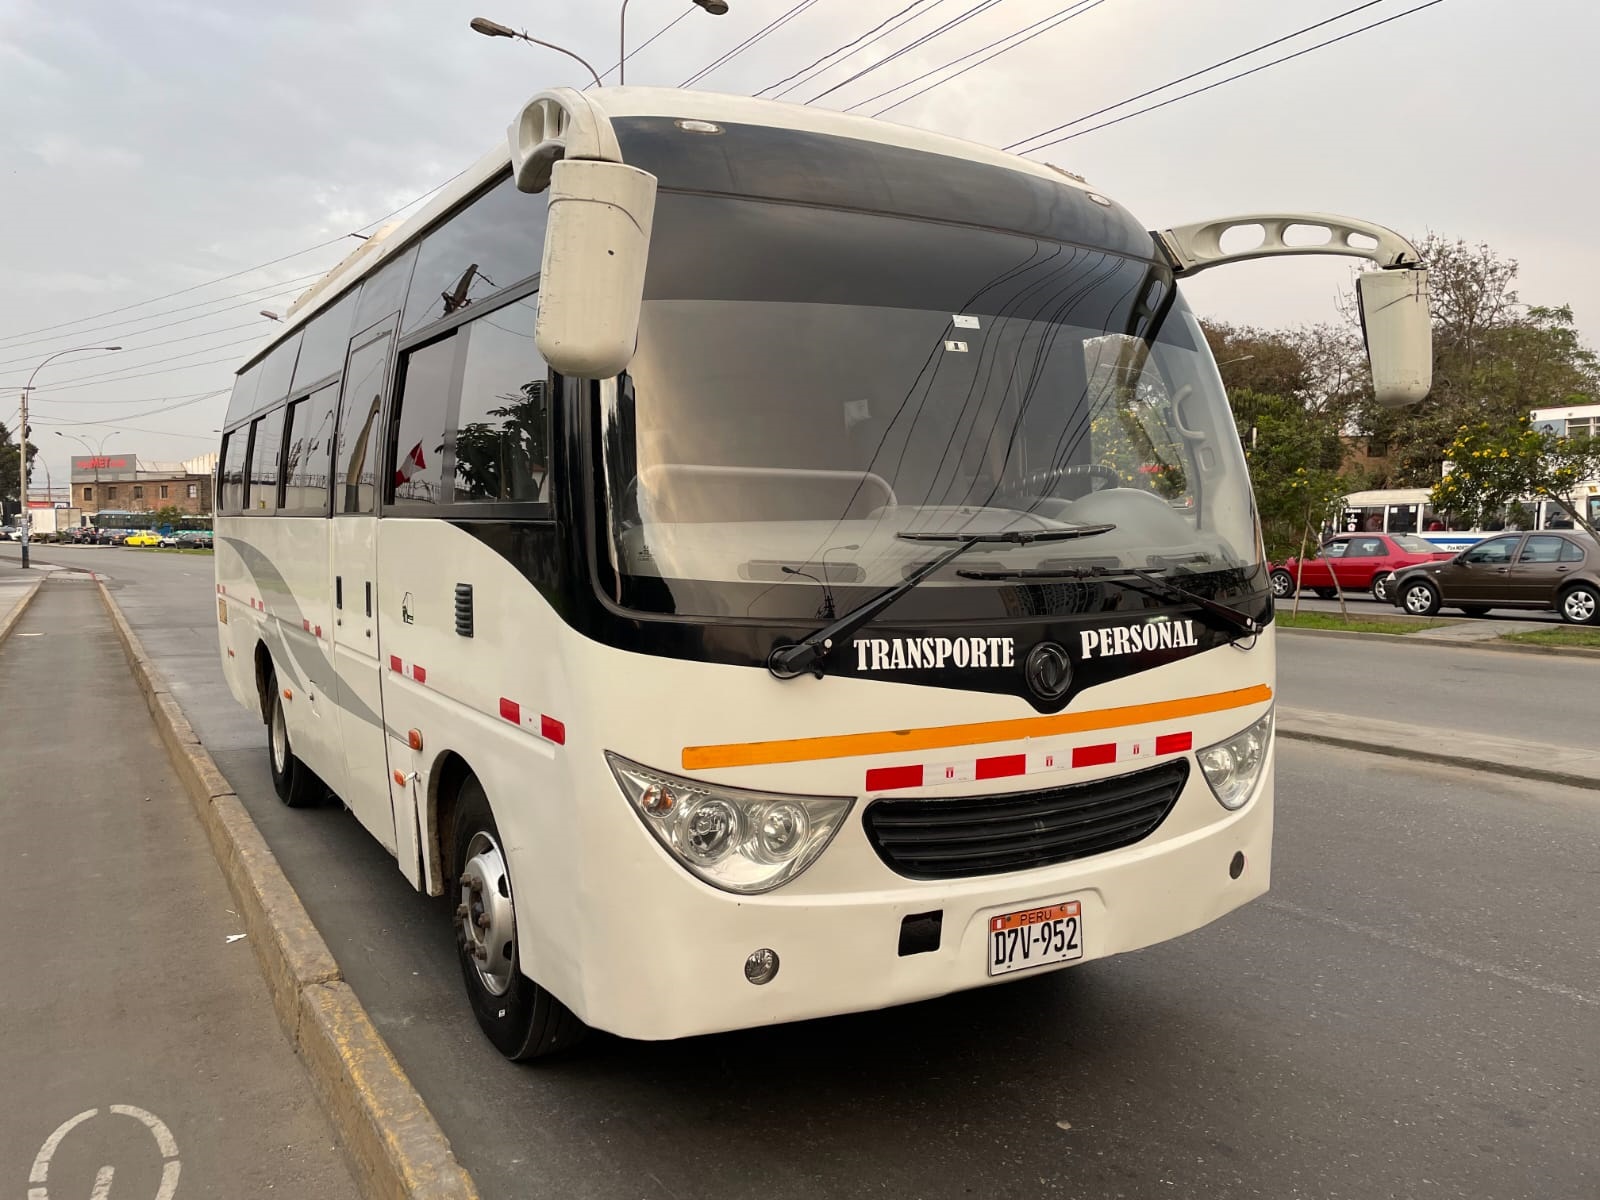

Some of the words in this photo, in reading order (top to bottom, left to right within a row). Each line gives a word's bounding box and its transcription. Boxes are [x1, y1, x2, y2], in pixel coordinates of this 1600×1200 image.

[853, 637, 1014, 671] TRANSPORTE
[1080, 620, 1198, 660] PERSONAL
[994, 917, 1078, 965] D7V-952
[1020, 910, 1052, 926] PERU
